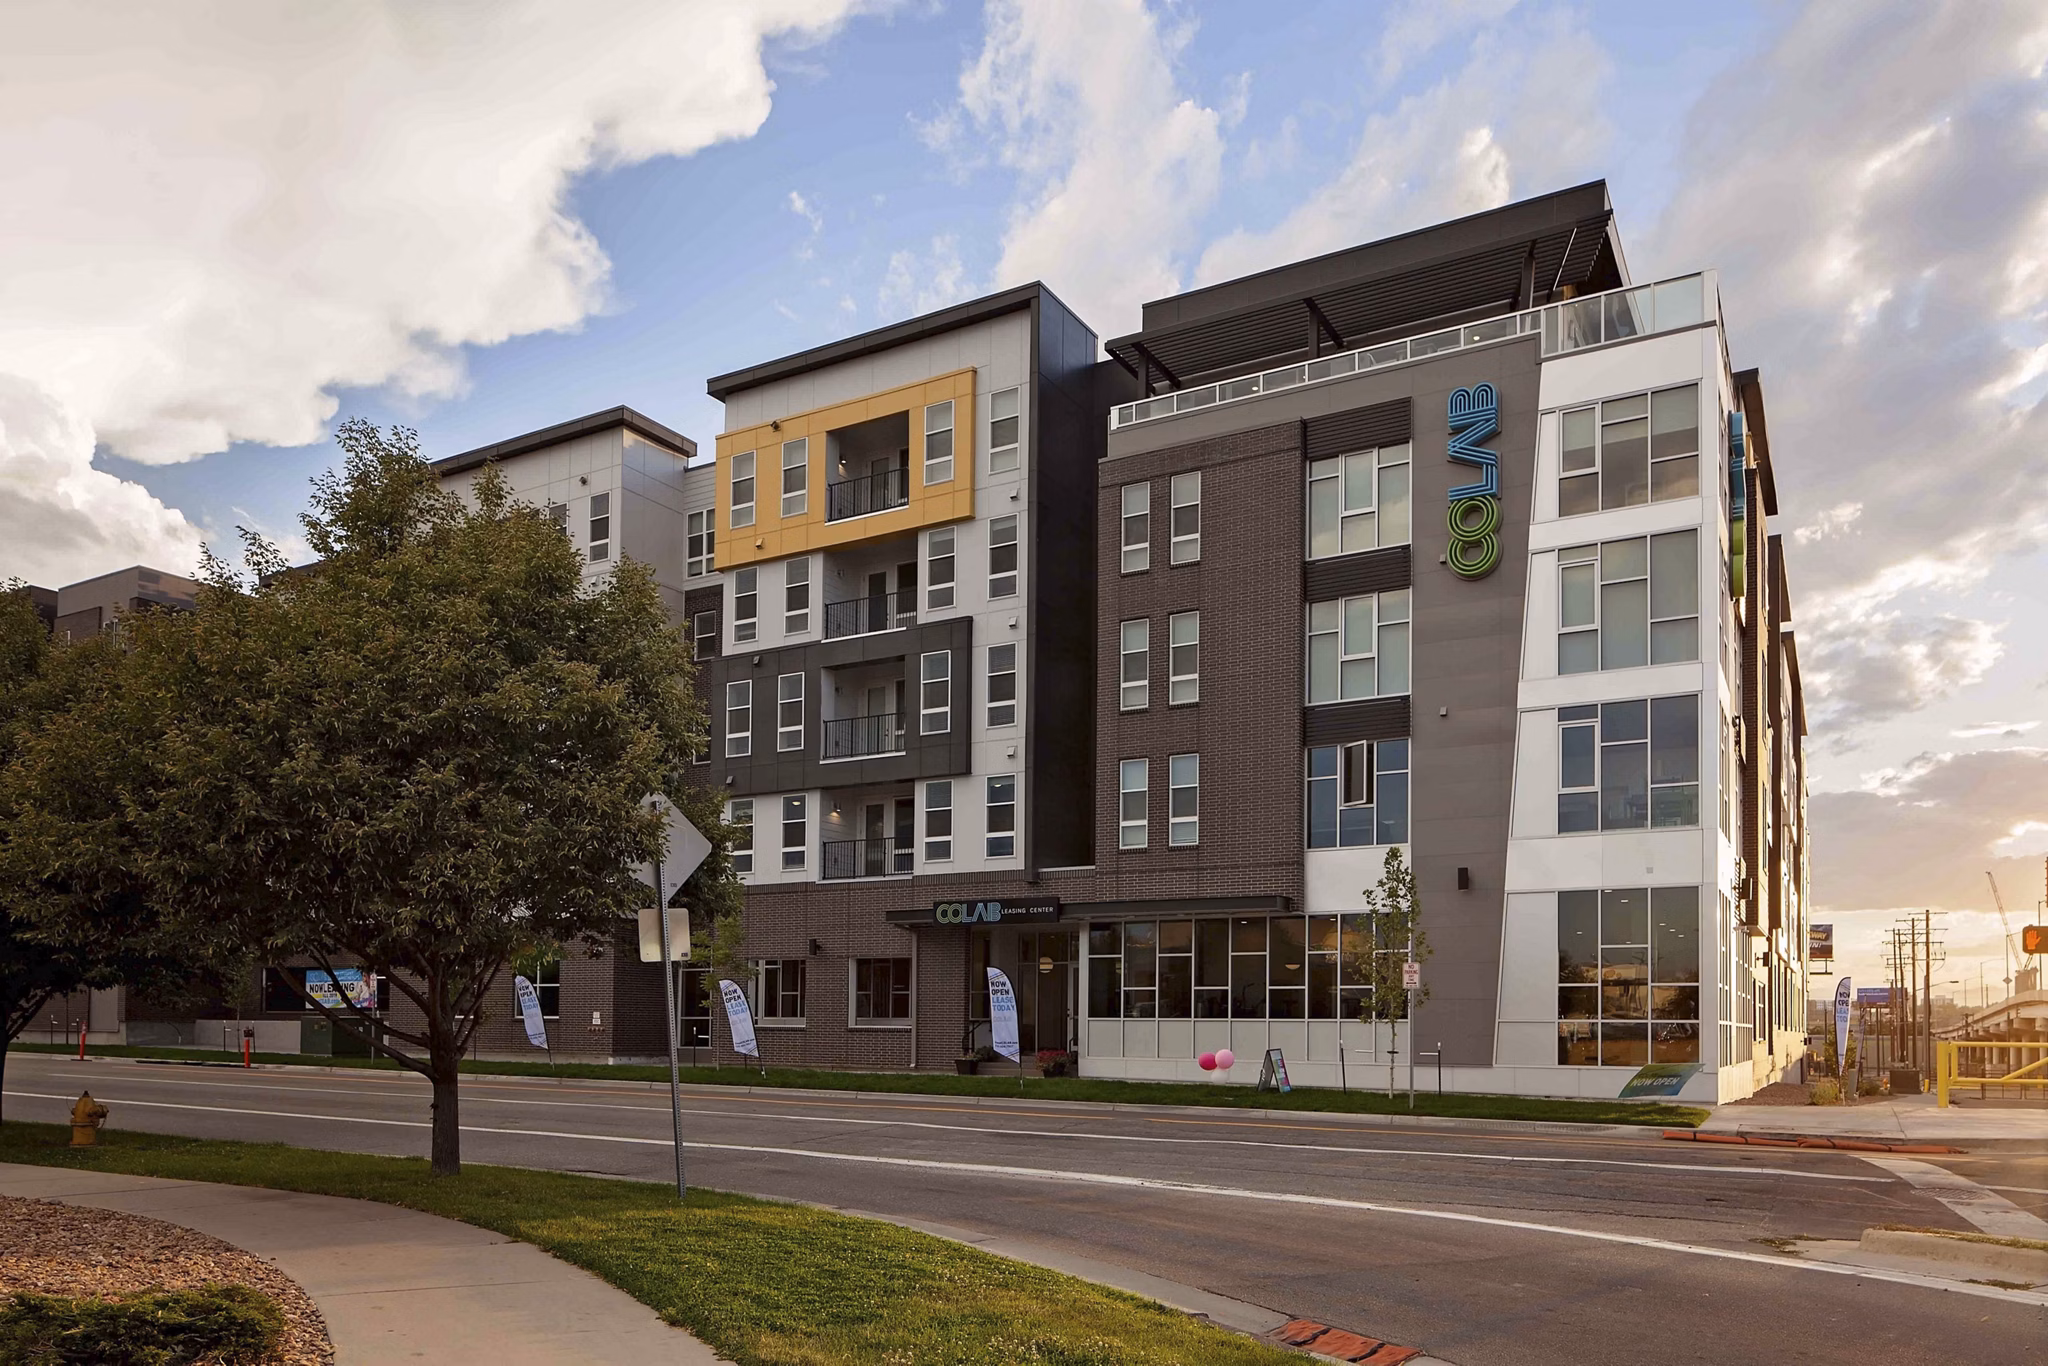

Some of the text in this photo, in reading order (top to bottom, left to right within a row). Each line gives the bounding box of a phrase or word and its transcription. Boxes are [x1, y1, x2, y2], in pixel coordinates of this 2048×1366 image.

[1447, 381, 1501, 579] COLAB
[936, 902, 1001, 923] COLAB
[724, 988, 738, 997] NOW
[991, 988, 1010, 996] OPEN
[725, 994, 742, 1003] OPEN
[992, 996, 1014, 1004] LEASE
[727, 1001, 746, 1010] LEASE
[992, 1004, 1015, 1012] TODAY
[728, 1007, 748, 1017] TODAY
[1630, 1076, 1680, 1086] NOW OPEN
